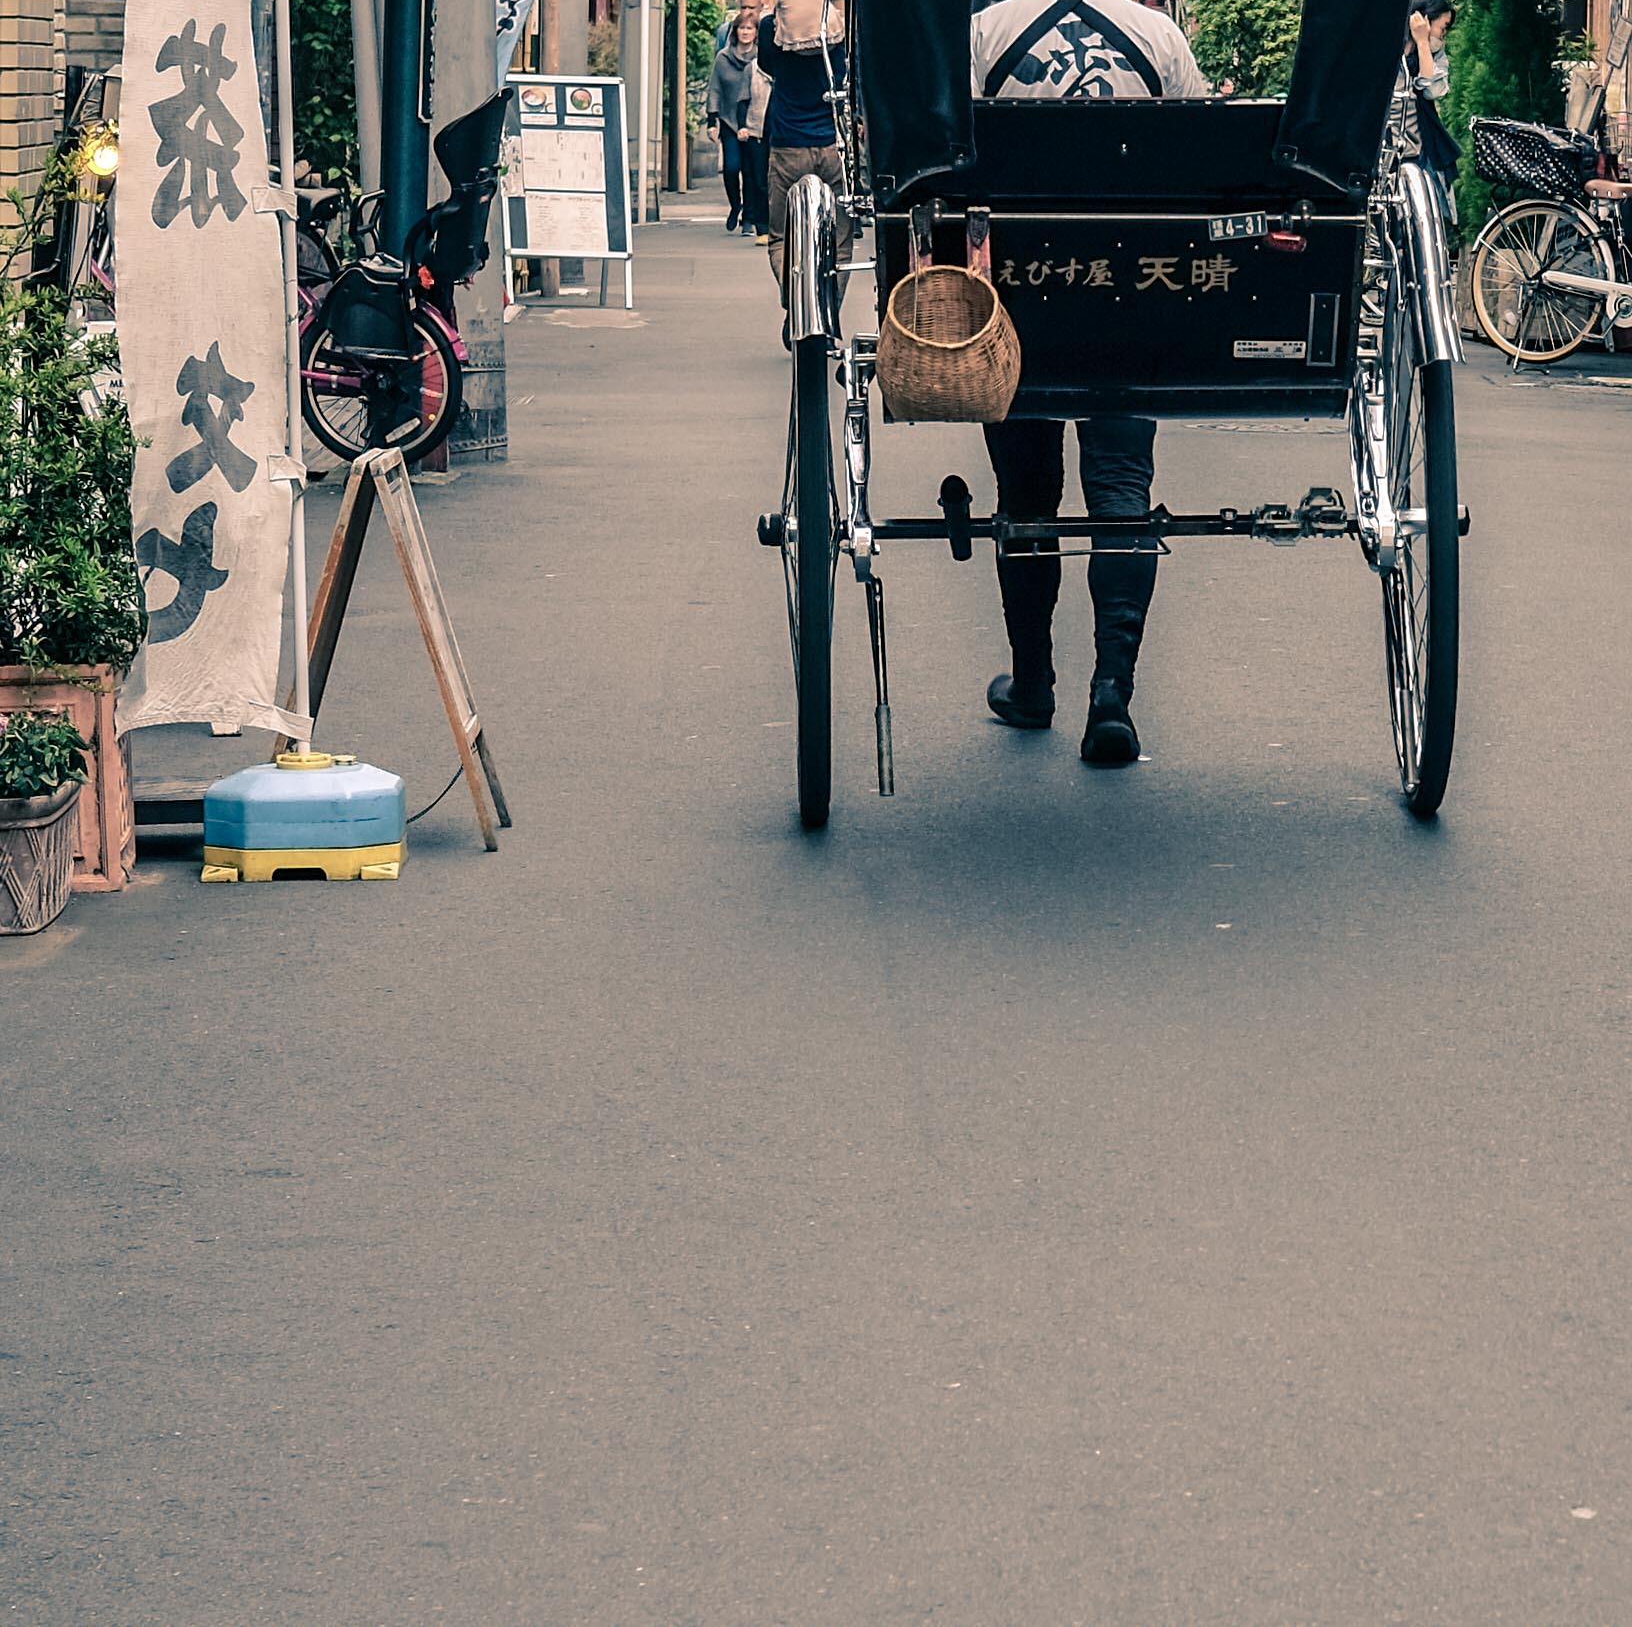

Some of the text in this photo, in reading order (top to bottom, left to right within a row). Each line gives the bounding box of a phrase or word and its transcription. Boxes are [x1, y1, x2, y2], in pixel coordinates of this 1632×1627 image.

[998, 253, 1240, 293] えびす屋 天晴
